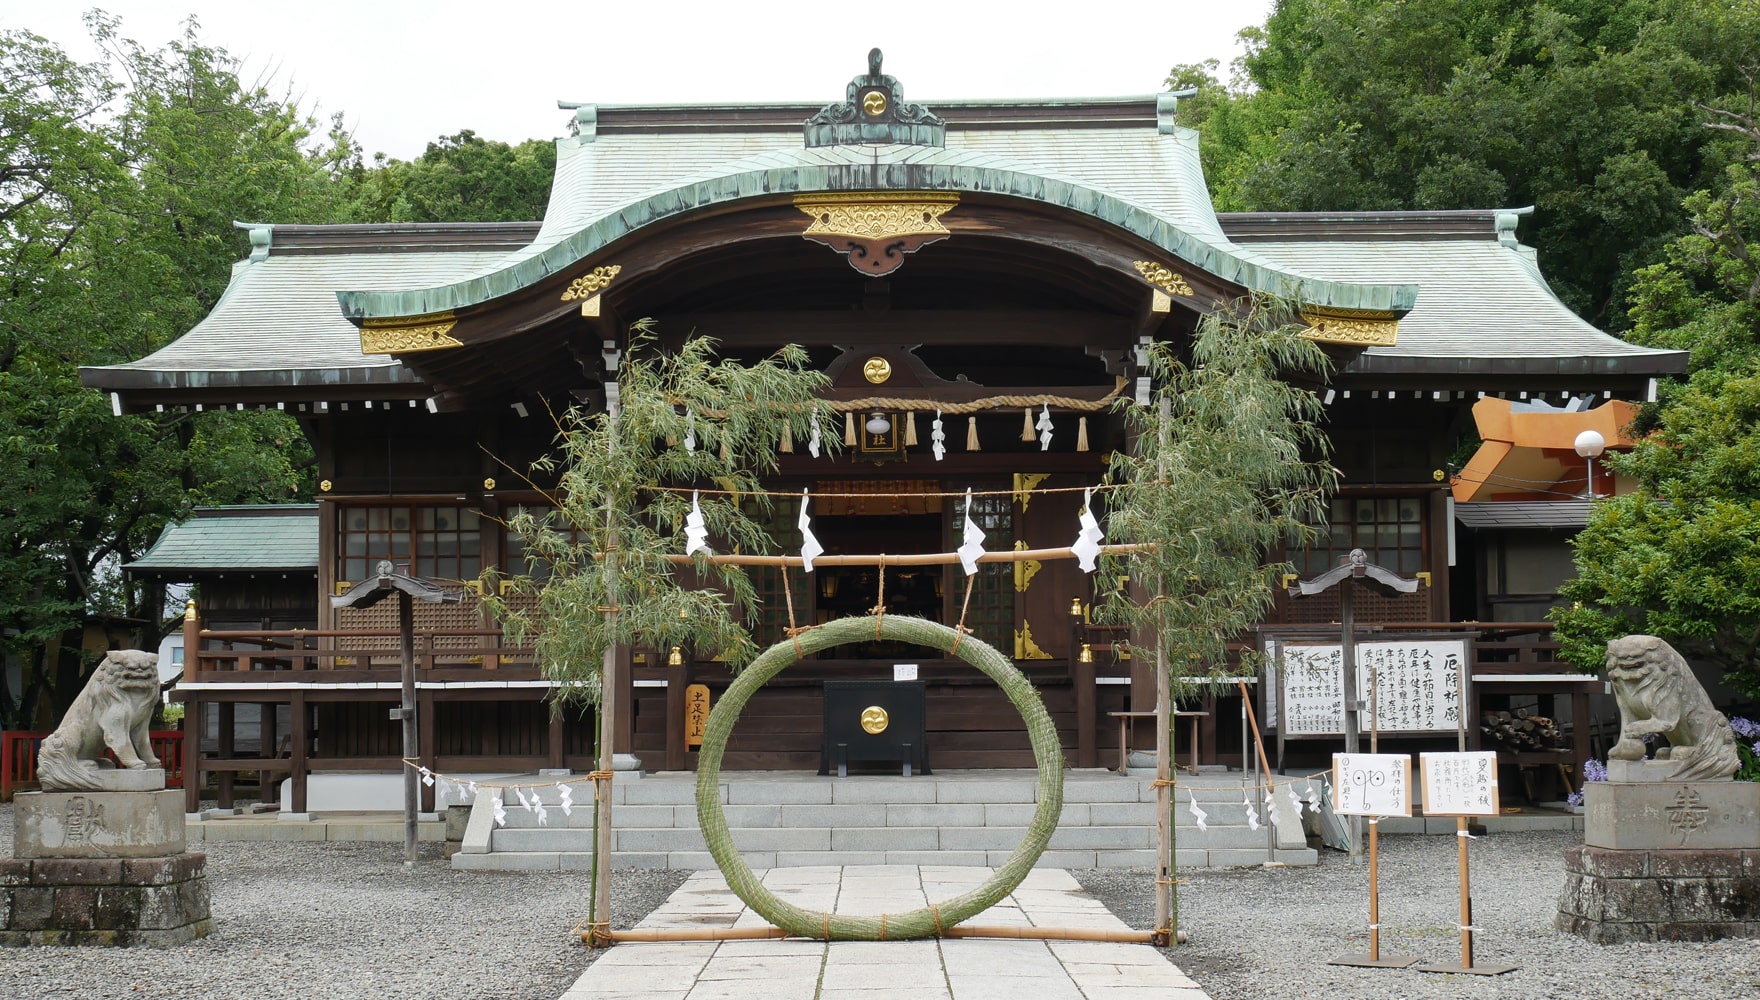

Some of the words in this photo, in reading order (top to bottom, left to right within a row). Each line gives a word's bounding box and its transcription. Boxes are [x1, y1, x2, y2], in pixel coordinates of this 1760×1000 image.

[1443, 653, 1459, 722] 厄除祈願
[691, 691, 705, 737] 土足禁止
[1389, 759, 1402, 809] 参拝の仕方
[1475, 758, 1490, 807] 夏越の祓
